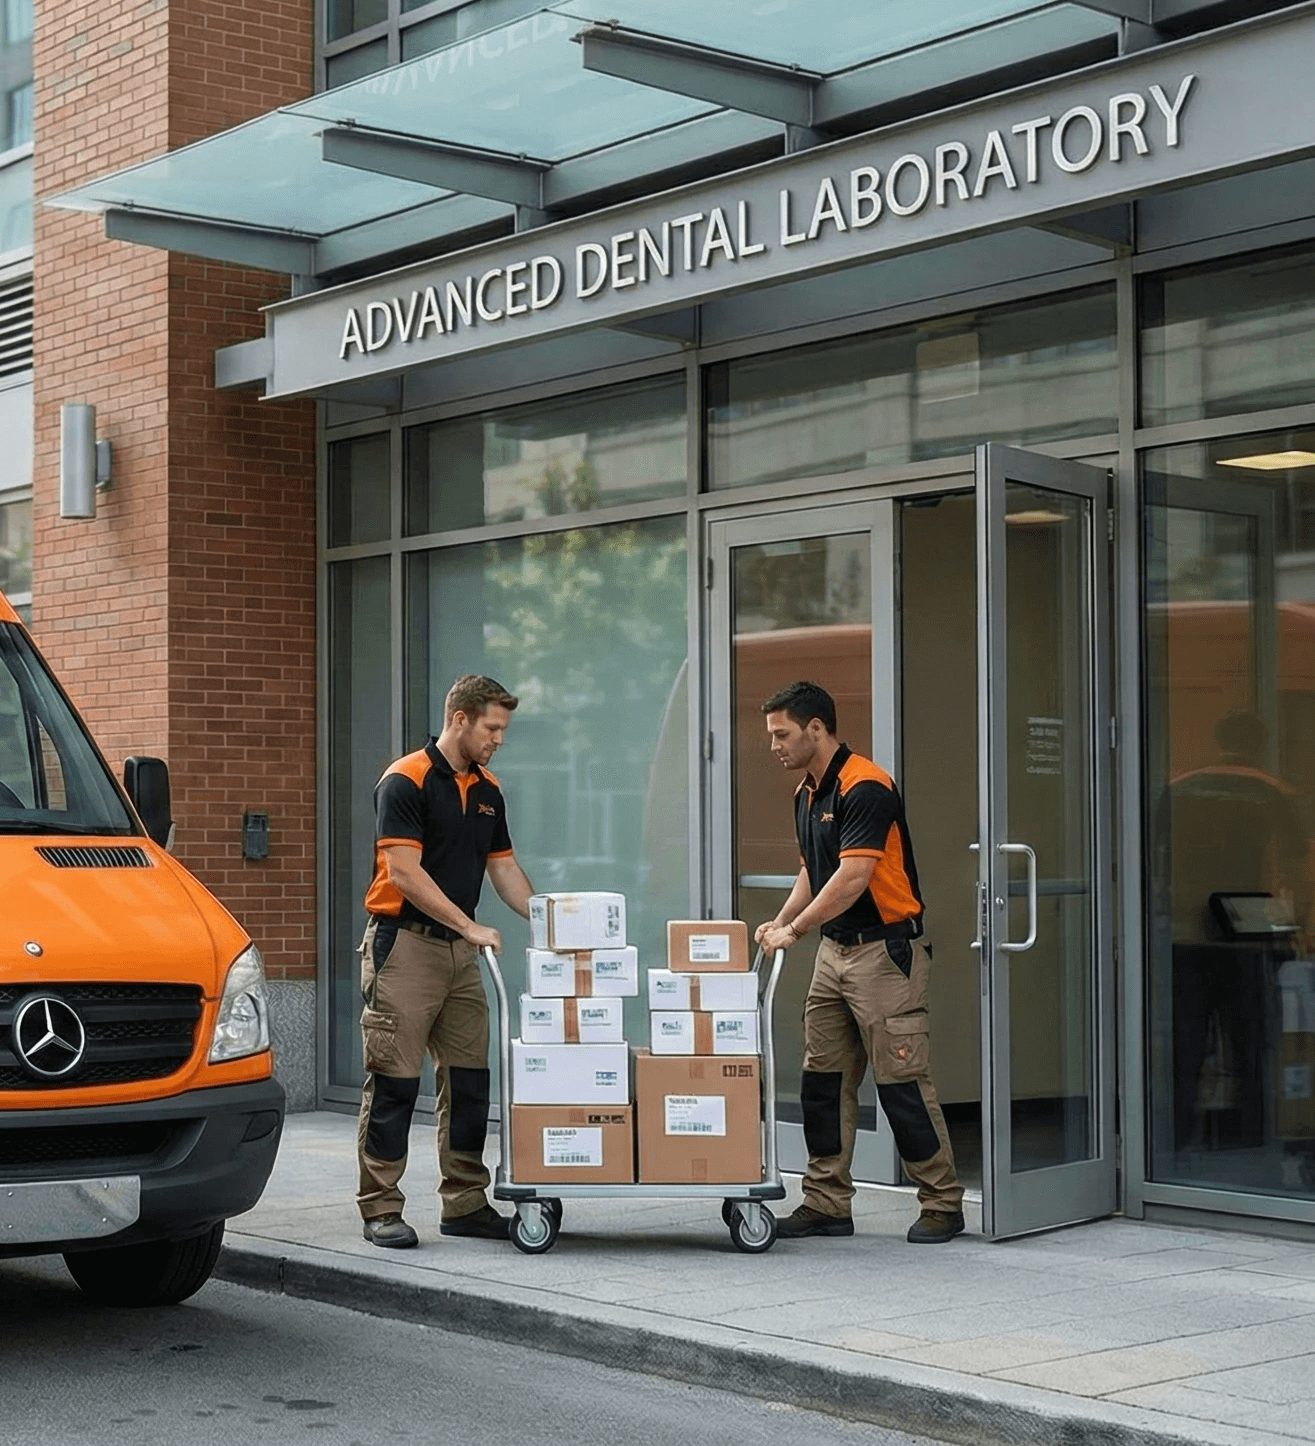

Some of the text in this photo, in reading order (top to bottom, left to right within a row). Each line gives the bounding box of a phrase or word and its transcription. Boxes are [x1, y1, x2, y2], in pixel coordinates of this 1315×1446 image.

[338, 74, 1197, 360] ADVANCED DENTAL LABORATORY
